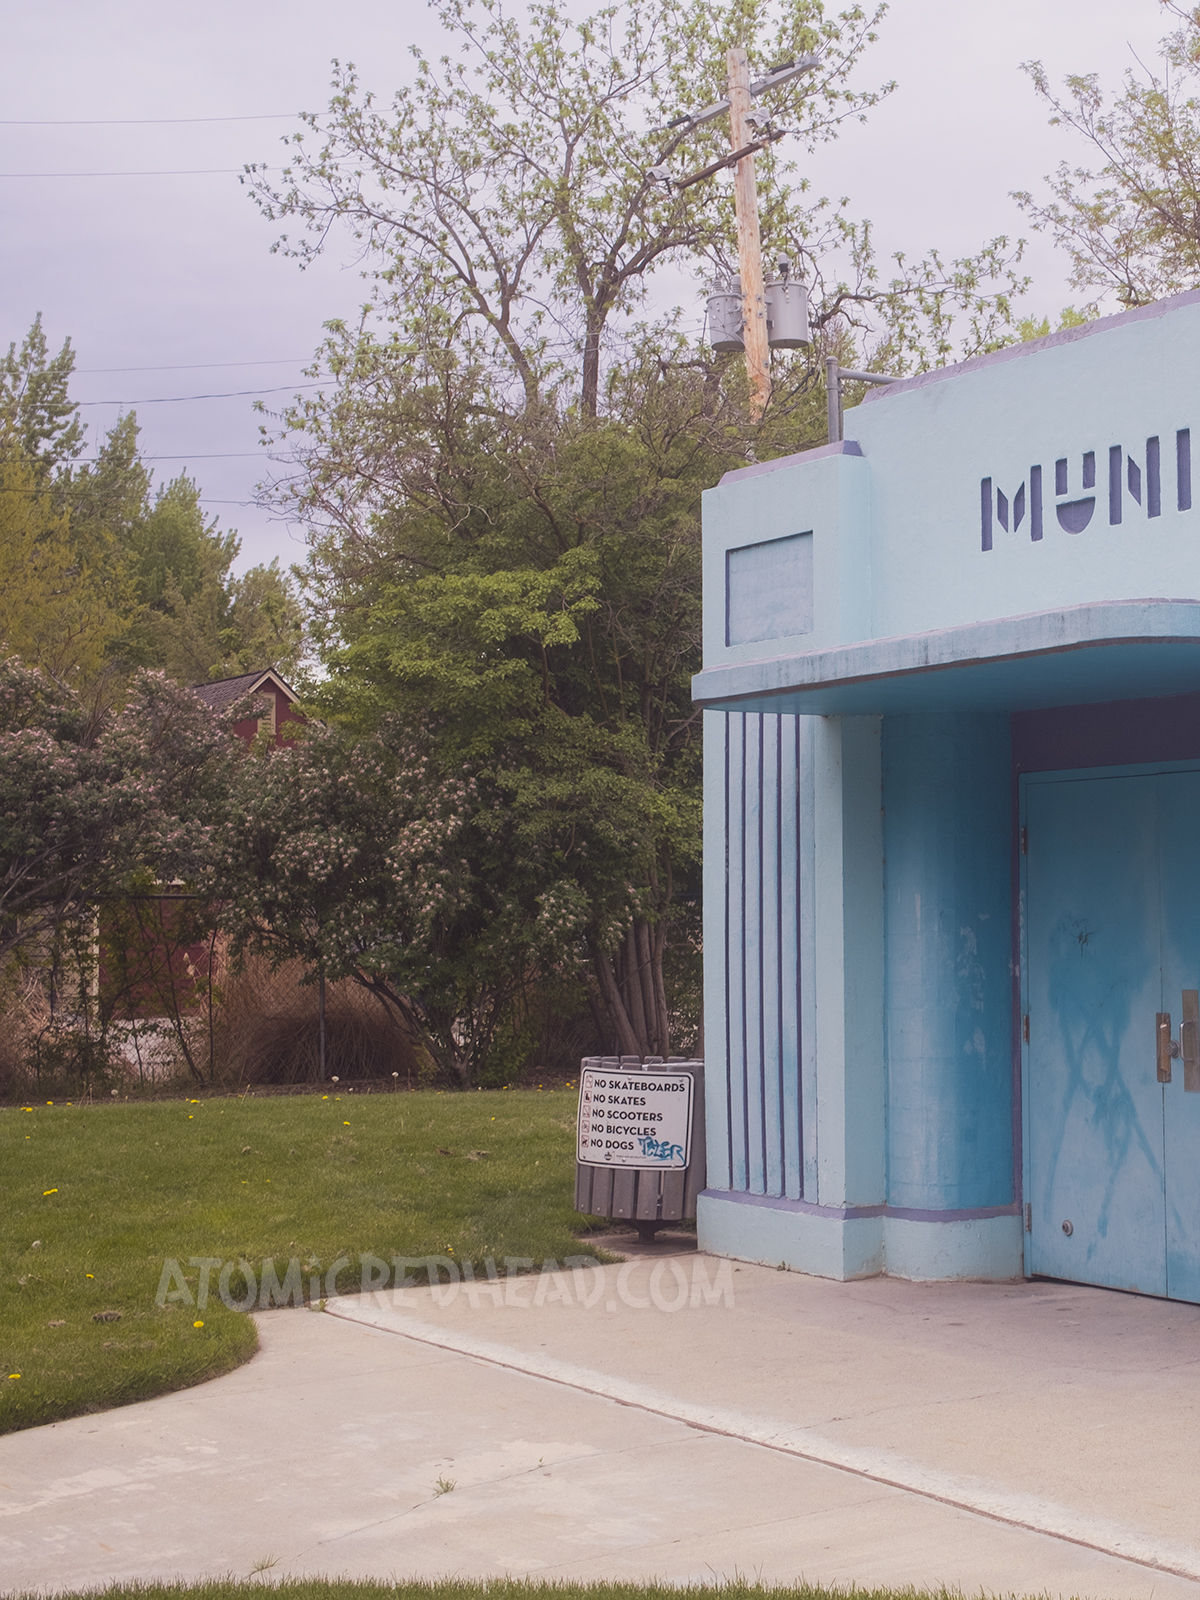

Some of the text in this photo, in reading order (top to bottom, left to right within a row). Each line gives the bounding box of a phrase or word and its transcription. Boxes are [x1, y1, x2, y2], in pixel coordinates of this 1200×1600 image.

[594, 1079, 686, 1092] NO SKATEBOARDS
[593, 1094, 646, 1106] NO SKATES
[592, 1109, 663, 1121] NO SCOOTERS
[591, 1124, 657, 1136] NO BICYCLES
[590, 1139, 635, 1151] NO DOGS
